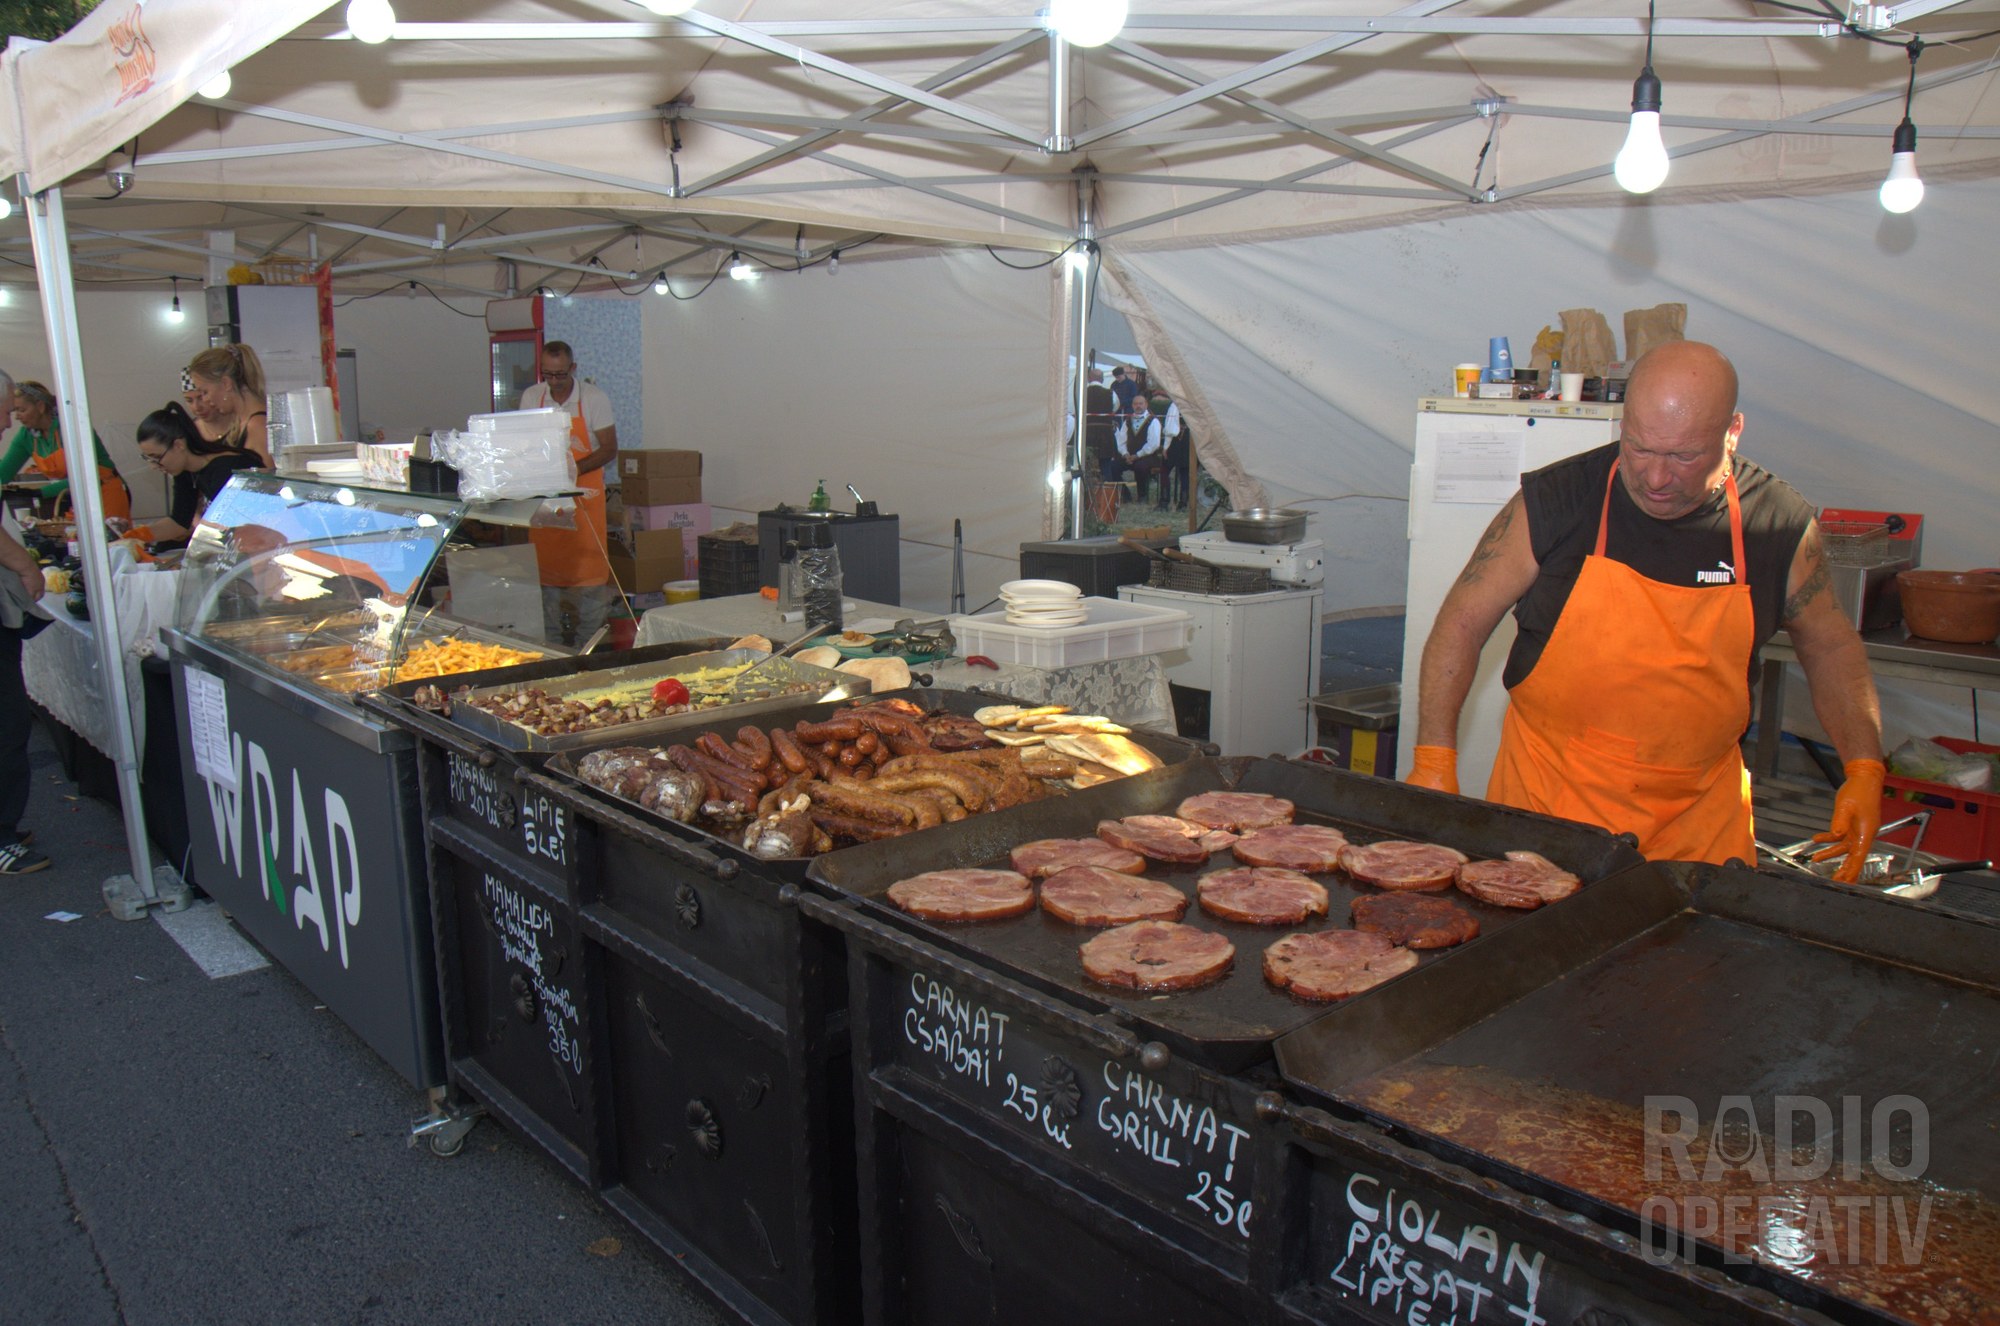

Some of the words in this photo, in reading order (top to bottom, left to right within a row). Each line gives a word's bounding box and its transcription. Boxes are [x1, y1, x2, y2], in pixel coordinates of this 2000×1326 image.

[1697, 571, 1730, 583] PUMA
[205, 731, 361, 970] WRAP
[1346, 1172, 1546, 1305] CIOLAN
[1347, 1220, 1493, 1323] PRESAT
